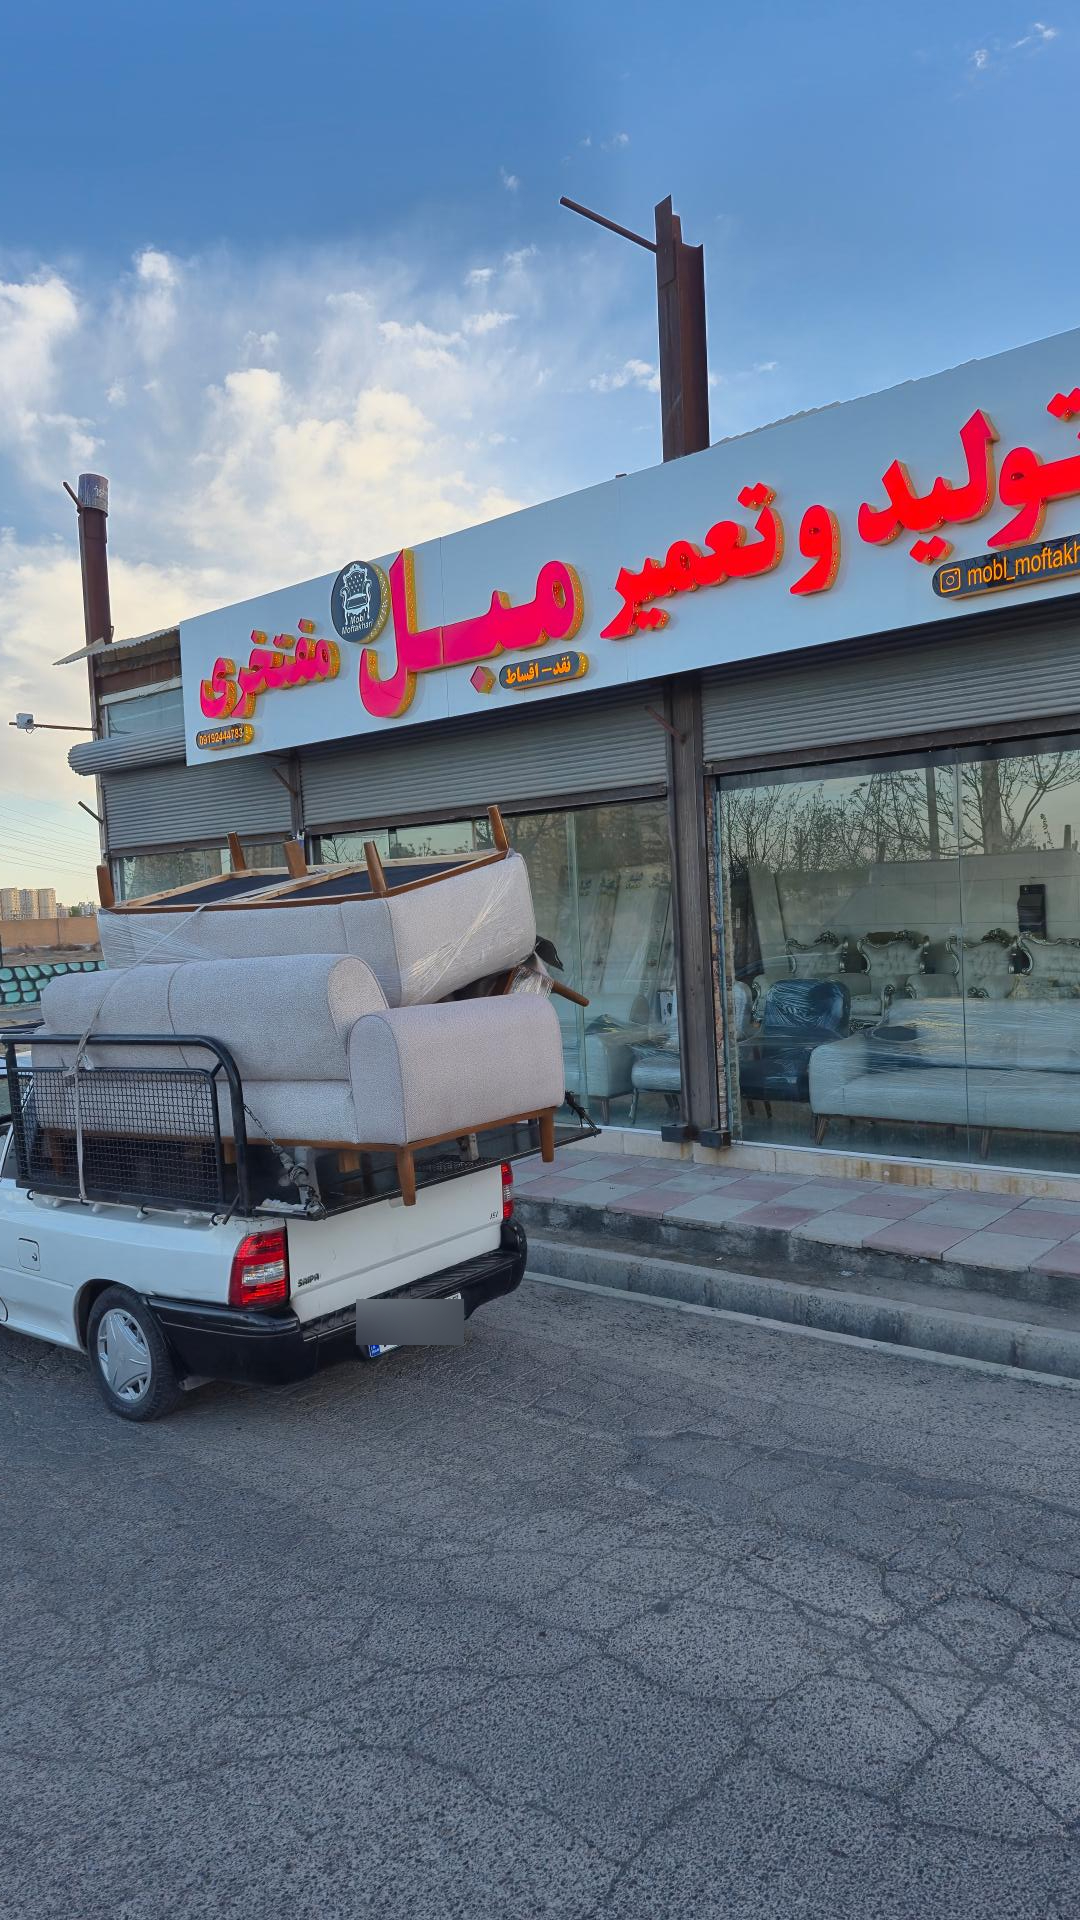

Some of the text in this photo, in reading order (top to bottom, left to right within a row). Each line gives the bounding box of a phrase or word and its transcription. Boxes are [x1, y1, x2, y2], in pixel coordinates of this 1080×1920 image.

[600, 482, 784, 640] تعمیر
[789, 504, 841, 596] و
[359, 548, 585, 718] مبل
[505, 662, 539, 684] اقساط
[199, 727, 243, 746] 09192444783
[297, 1273, 320, 1288] SAIPA
